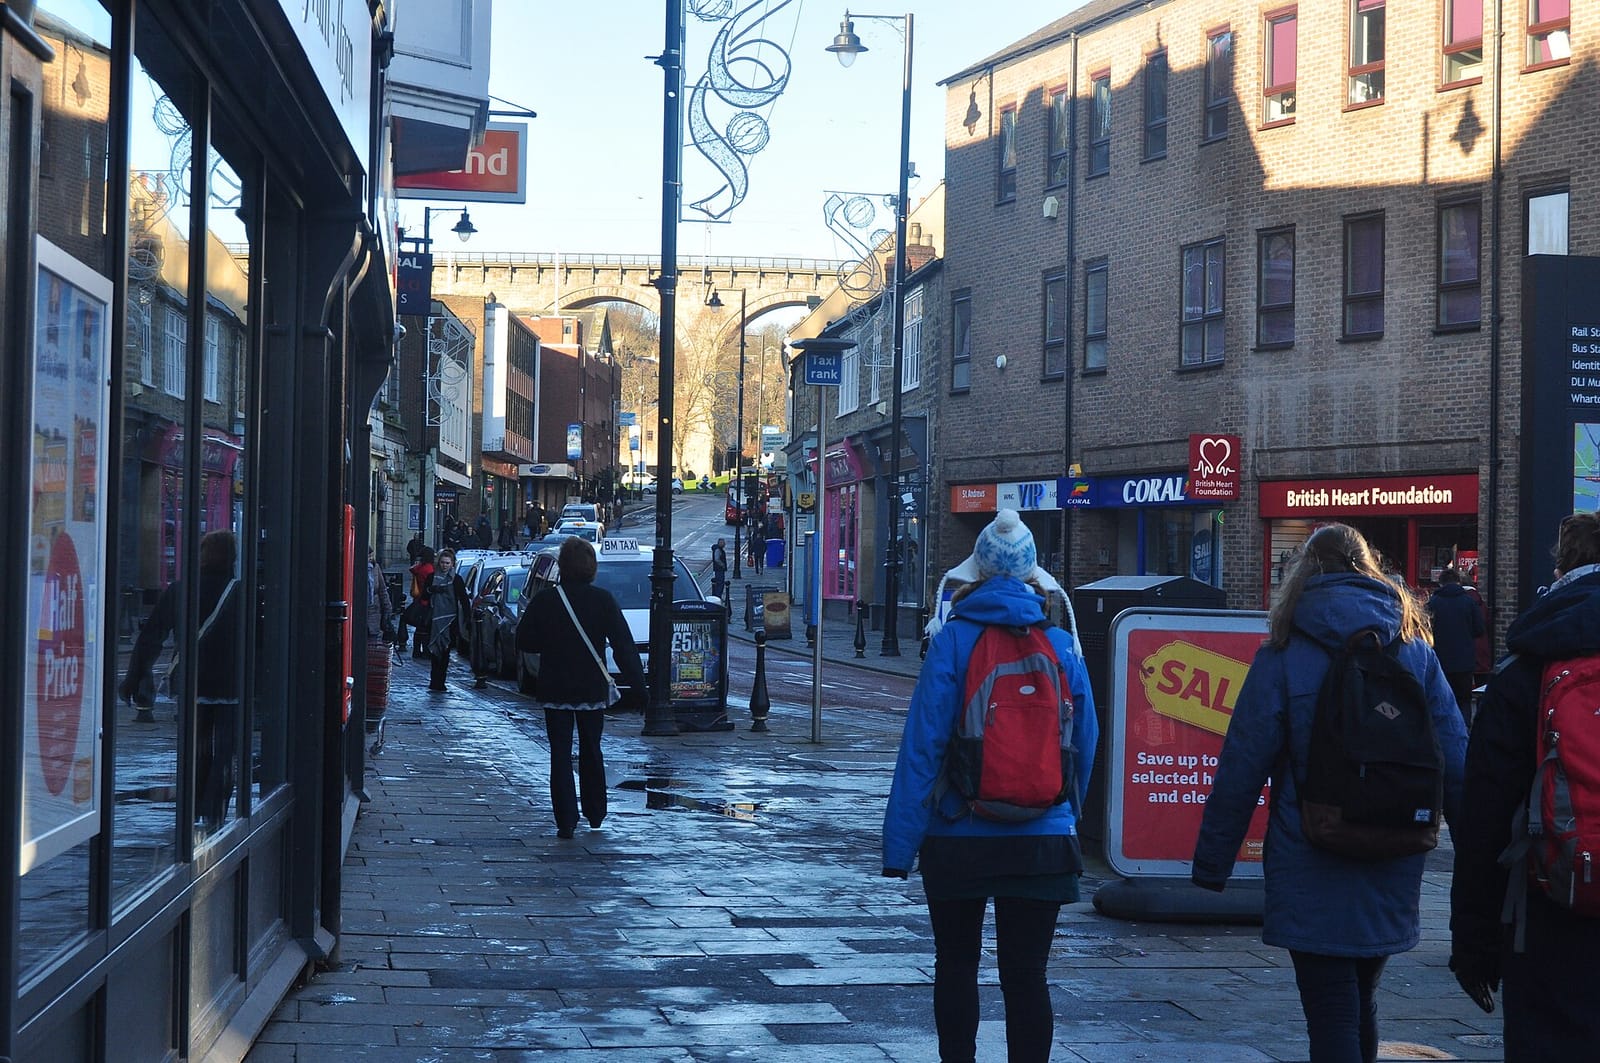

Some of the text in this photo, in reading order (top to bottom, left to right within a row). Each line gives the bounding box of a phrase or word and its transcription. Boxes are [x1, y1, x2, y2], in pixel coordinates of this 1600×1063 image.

[448, 148, 508, 176] nd
[1571, 326, 1588, 337] Rail
[1572, 343, 1588, 353] Bus
[812, 354, 836, 366] Taxi
[811, 369, 838, 379] rank
[1123, 477, 1185, 503] CORAL
[1195, 479, 1233, 488] British Heart
[1018, 483, 1046, 509] VIP
[1195, 487, 1233, 496] Foundation
[1287, 485, 1452, 507] British Heart Foundation
[604, 540, 638, 551] BM TAXI
[50, 573, 79, 632] Half
[673, 623, 690, 632] WIN
[672, 632, 711, 652] £500
[45, 641, 79, 701] Price
[1156, 659, 1234, 716] SAL
[1137, 752, 1218, 769] Save up to
[1132, 771, 1198, 785] selected
[1148, 790, 1178, 803] and
